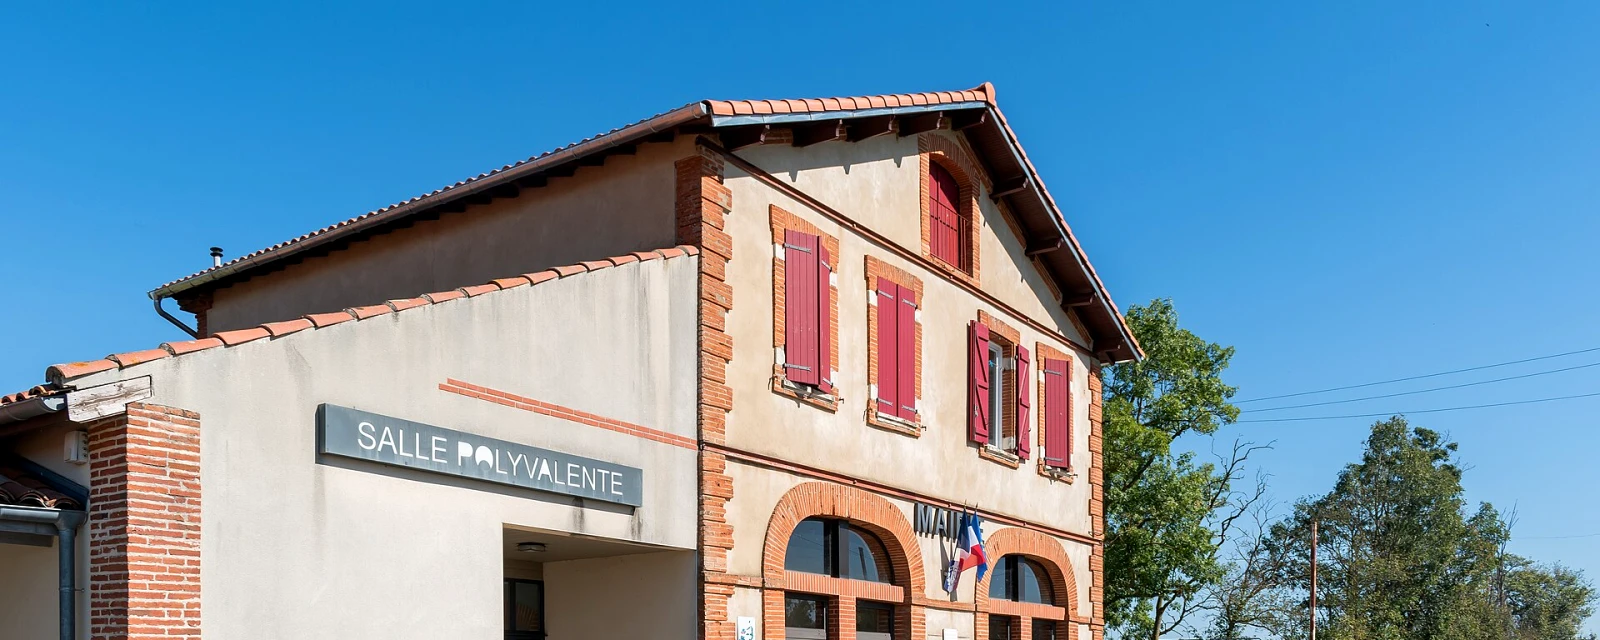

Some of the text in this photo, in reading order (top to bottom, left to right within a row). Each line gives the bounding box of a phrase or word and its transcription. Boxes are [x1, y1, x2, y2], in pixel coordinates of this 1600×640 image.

[357, 421, 623, 496] SALLE POLYVALENTE
[914, 502, 984, 545] MAI
